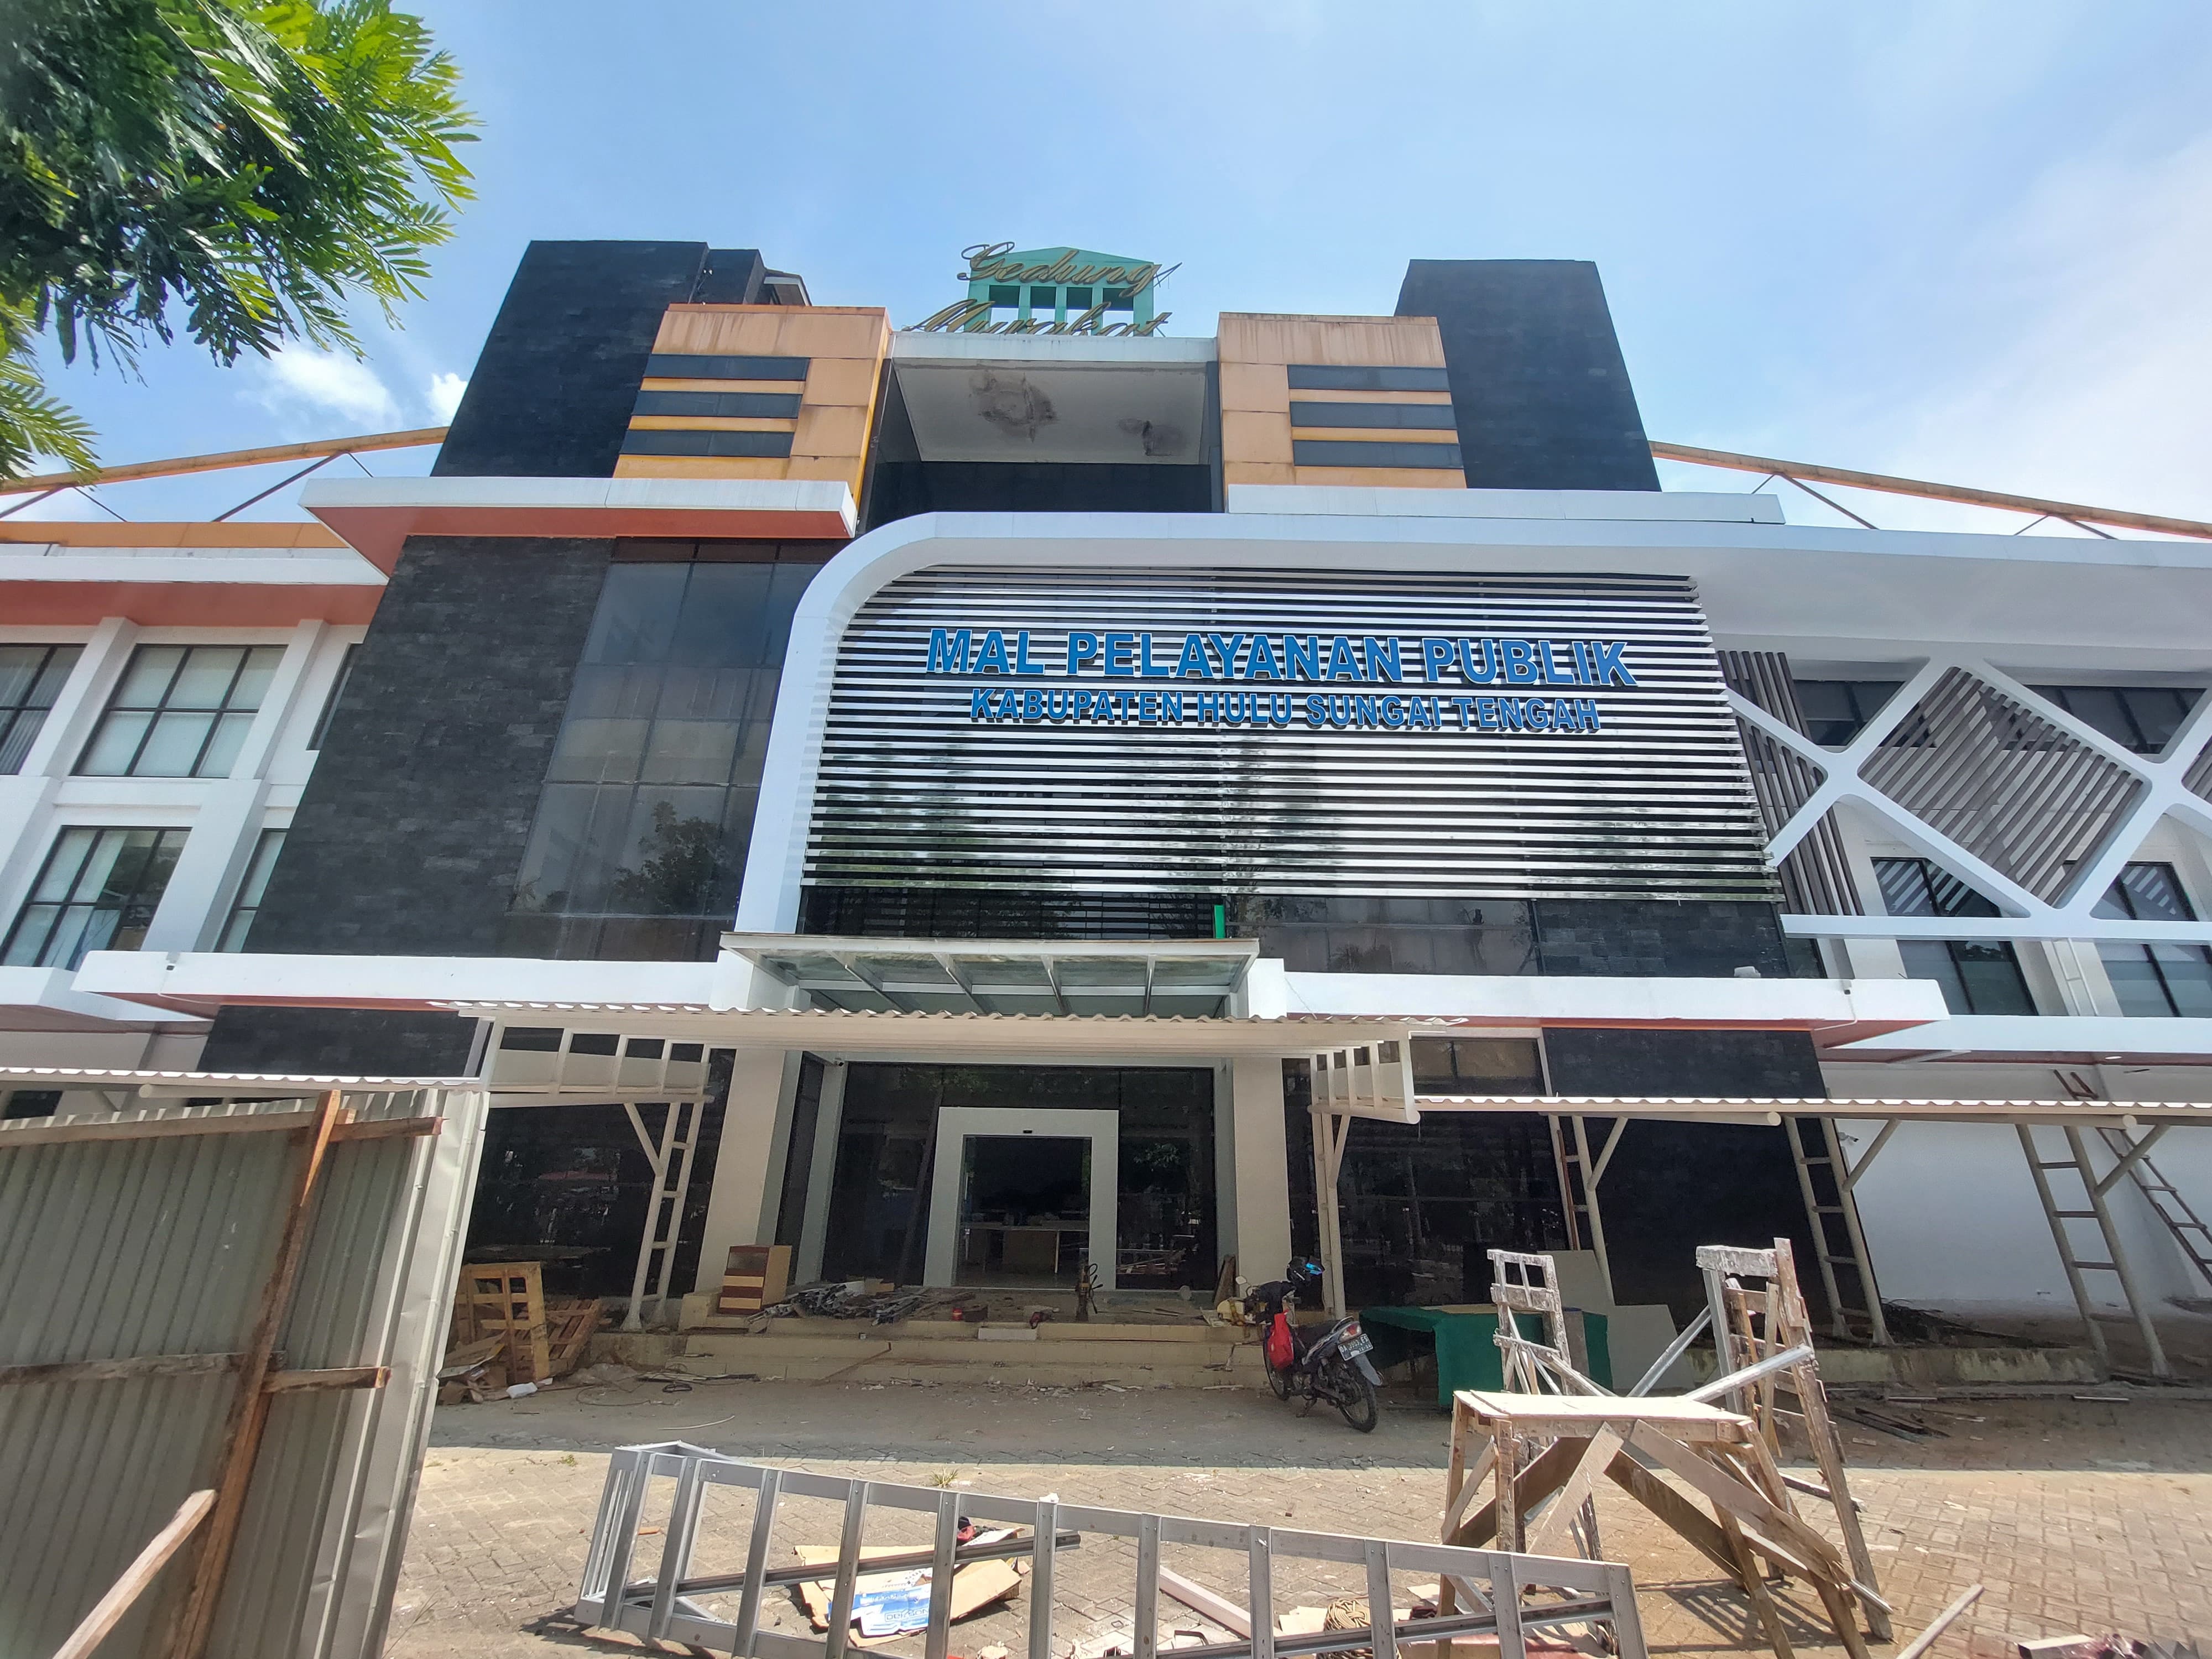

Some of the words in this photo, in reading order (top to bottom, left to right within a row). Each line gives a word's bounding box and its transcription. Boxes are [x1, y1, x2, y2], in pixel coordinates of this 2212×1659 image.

[957, 242, 1182, 298] Gedung
[926, 628, 1045, 676] MAL
[1067, 631, 1403, 682] PELAYANAN
[1421, 638, 1637, 686] PUBLIK
[971, 688, 1183, 722] KABUPATEN
[1197, 692, 1292, 724] HULU
[1306, 695, 1442, 726] SUNGAI
[1451, 697, 1601, 729] TENGAH
